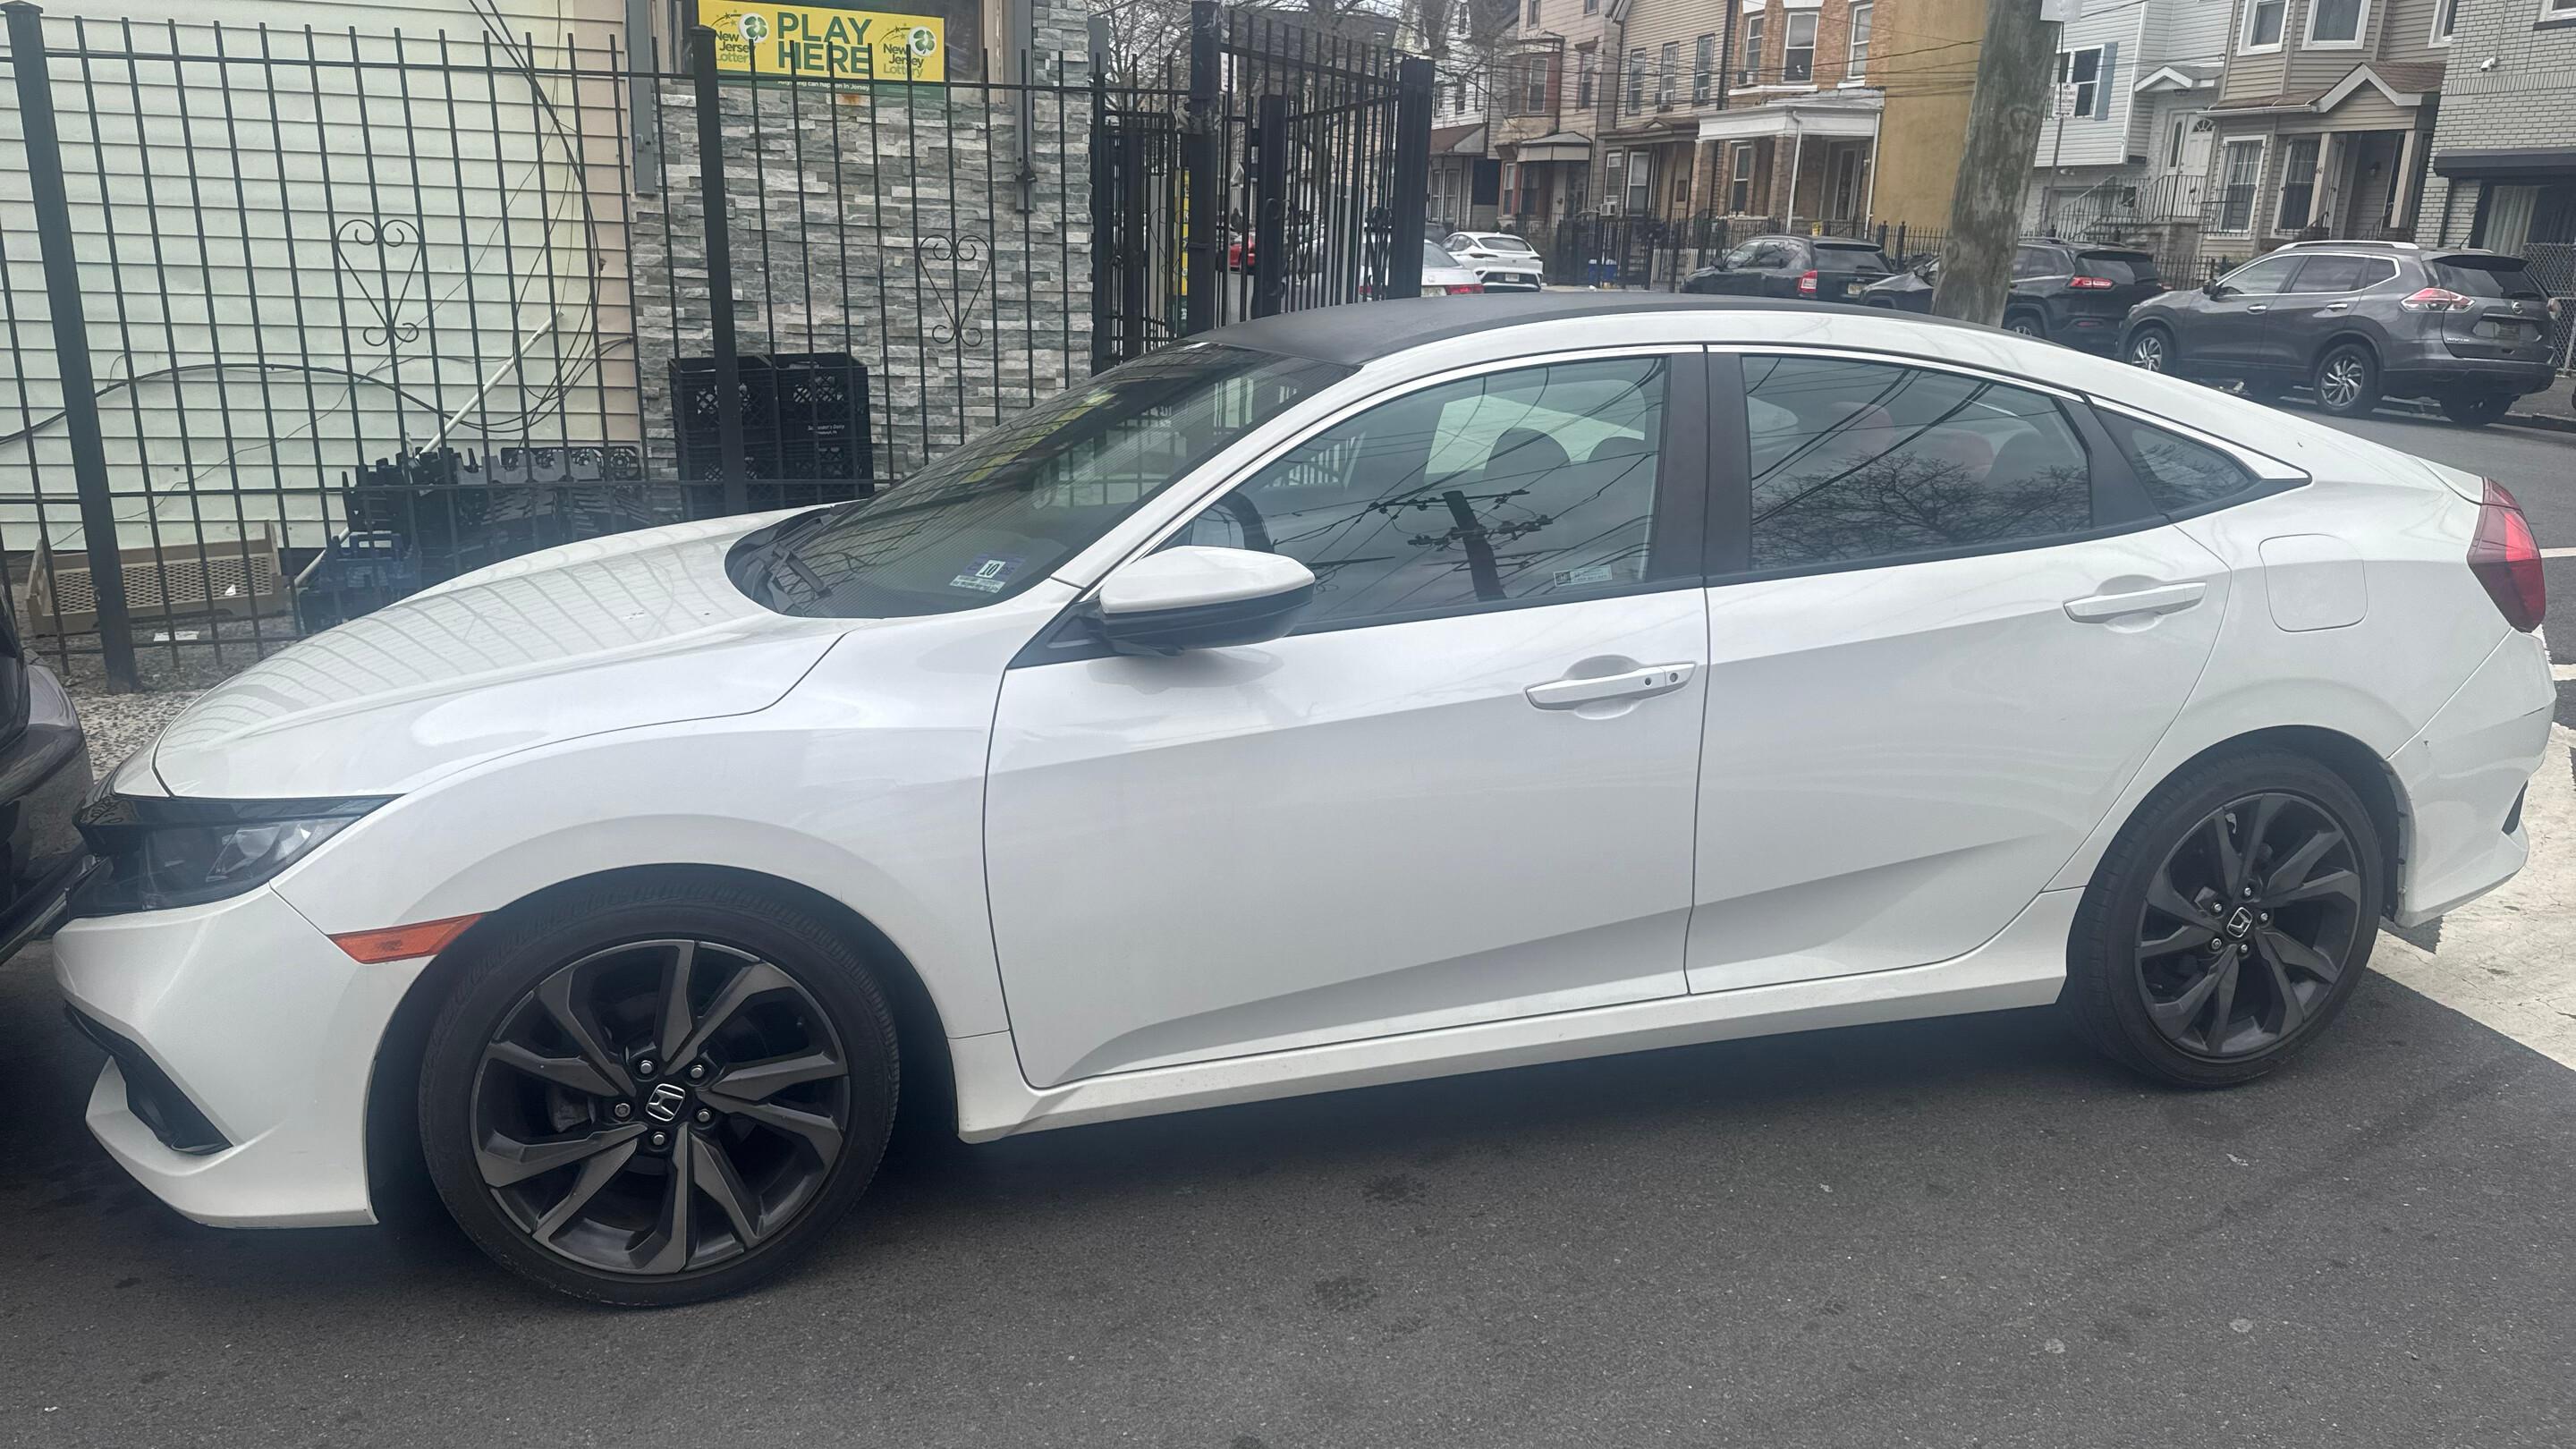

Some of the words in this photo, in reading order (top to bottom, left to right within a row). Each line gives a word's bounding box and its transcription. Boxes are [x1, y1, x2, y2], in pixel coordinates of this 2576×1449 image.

[777, 12, 873, 45] PLAY
[719, 41, 756, 54] Jerse
[883, 43, 909, 55] New
[778, 40, 873, 73] HERE
[889, 55, 924, 68] Jerey
[883, 64, 924, 78] Lottry
[979, 563, 1000, 576] 10
